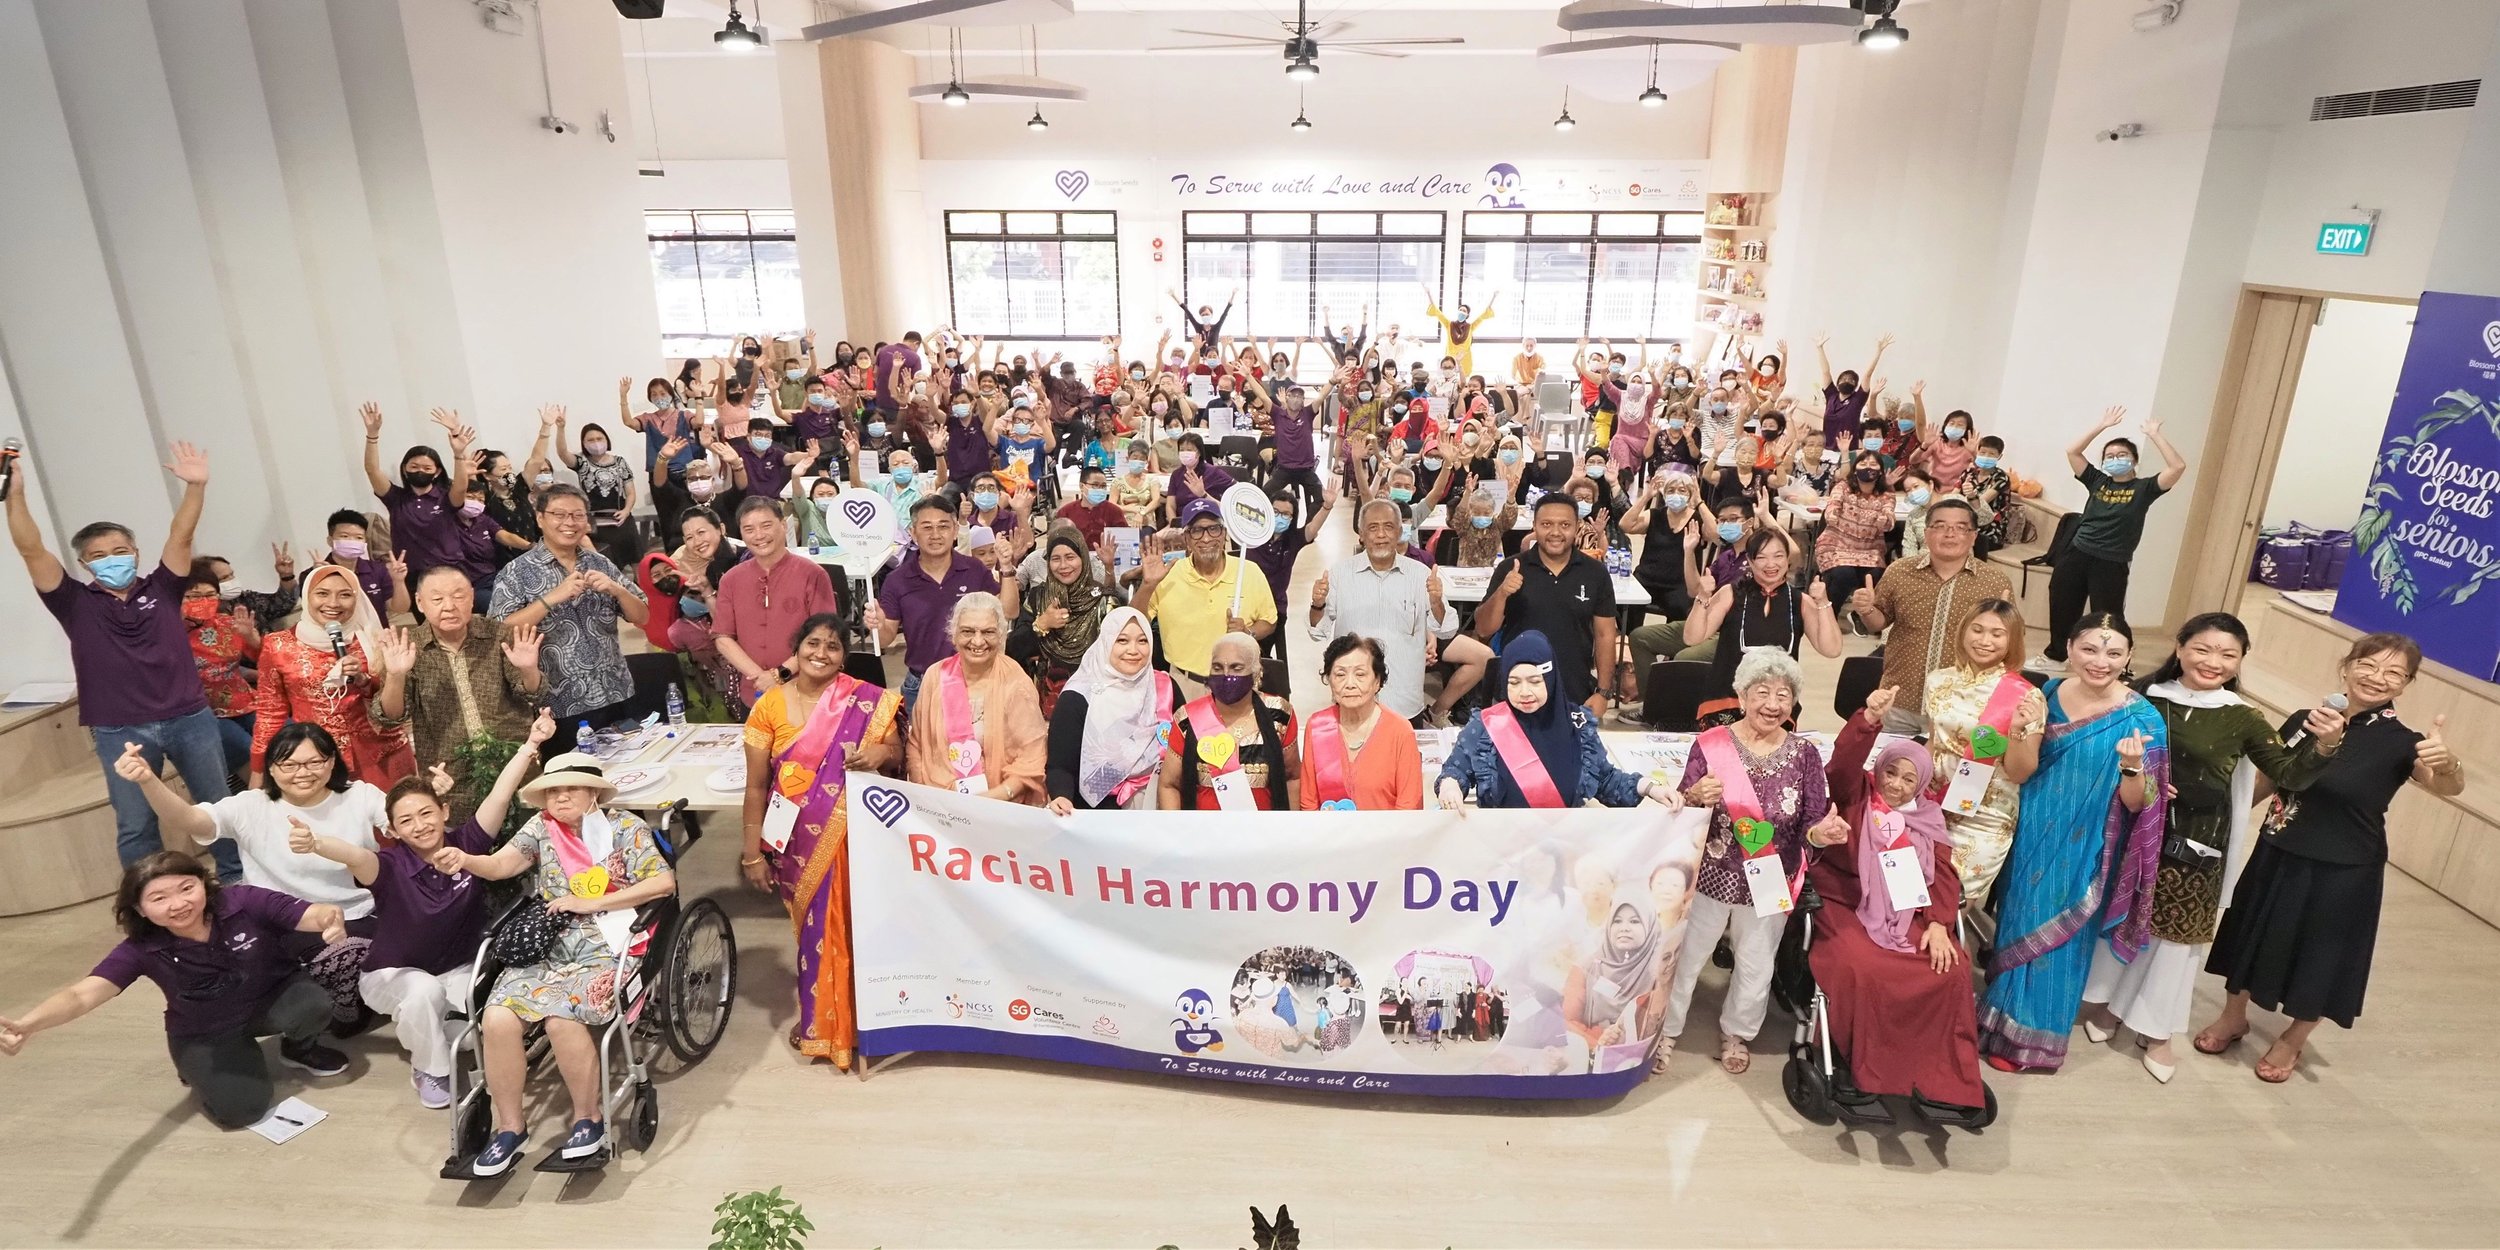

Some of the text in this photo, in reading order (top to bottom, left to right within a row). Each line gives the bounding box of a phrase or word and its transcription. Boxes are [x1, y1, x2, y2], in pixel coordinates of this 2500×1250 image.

[1171, 174, 1471, 198] To Serve with Love and Care
[2322, 228, 2356, 249] EXIT
[2469, 359, 2496, 370] Blossom
[2407, 442, 2500, 493] Blosso
[2420, 476, 2493, 518] Seeds
[2427, 507, 2450, 526] for
[2394, 520, 2494, 568] seniors
[2429, 555, 2453, 568] status)
[1213, 742, 1227, 757] 10
[1977, 738, 1996, 756] 2
[960, 750, 973, 768] 8
[916, 804, 972, 826] Blossom Seeds
[1745, 828, 1764, 845] 1
[1880, 821, 1898, 838] 4
[588, 876, 601, 894] 6
[908, 833, 1519, 927] Racial Harmony Day
[867, 973, 938, 984] Sector Administrator
[956, 977, 982, 986] Member
[1027, 984, 1054, 996] Operator
[966, 1001, 994, 1013] NCSS
[1082, 996, 1117, 1007] Supported
[1011, 1005, 1065, 1021] SG Cares
[1160, 1057, 1390, 1089] To Serve with Love and Care
